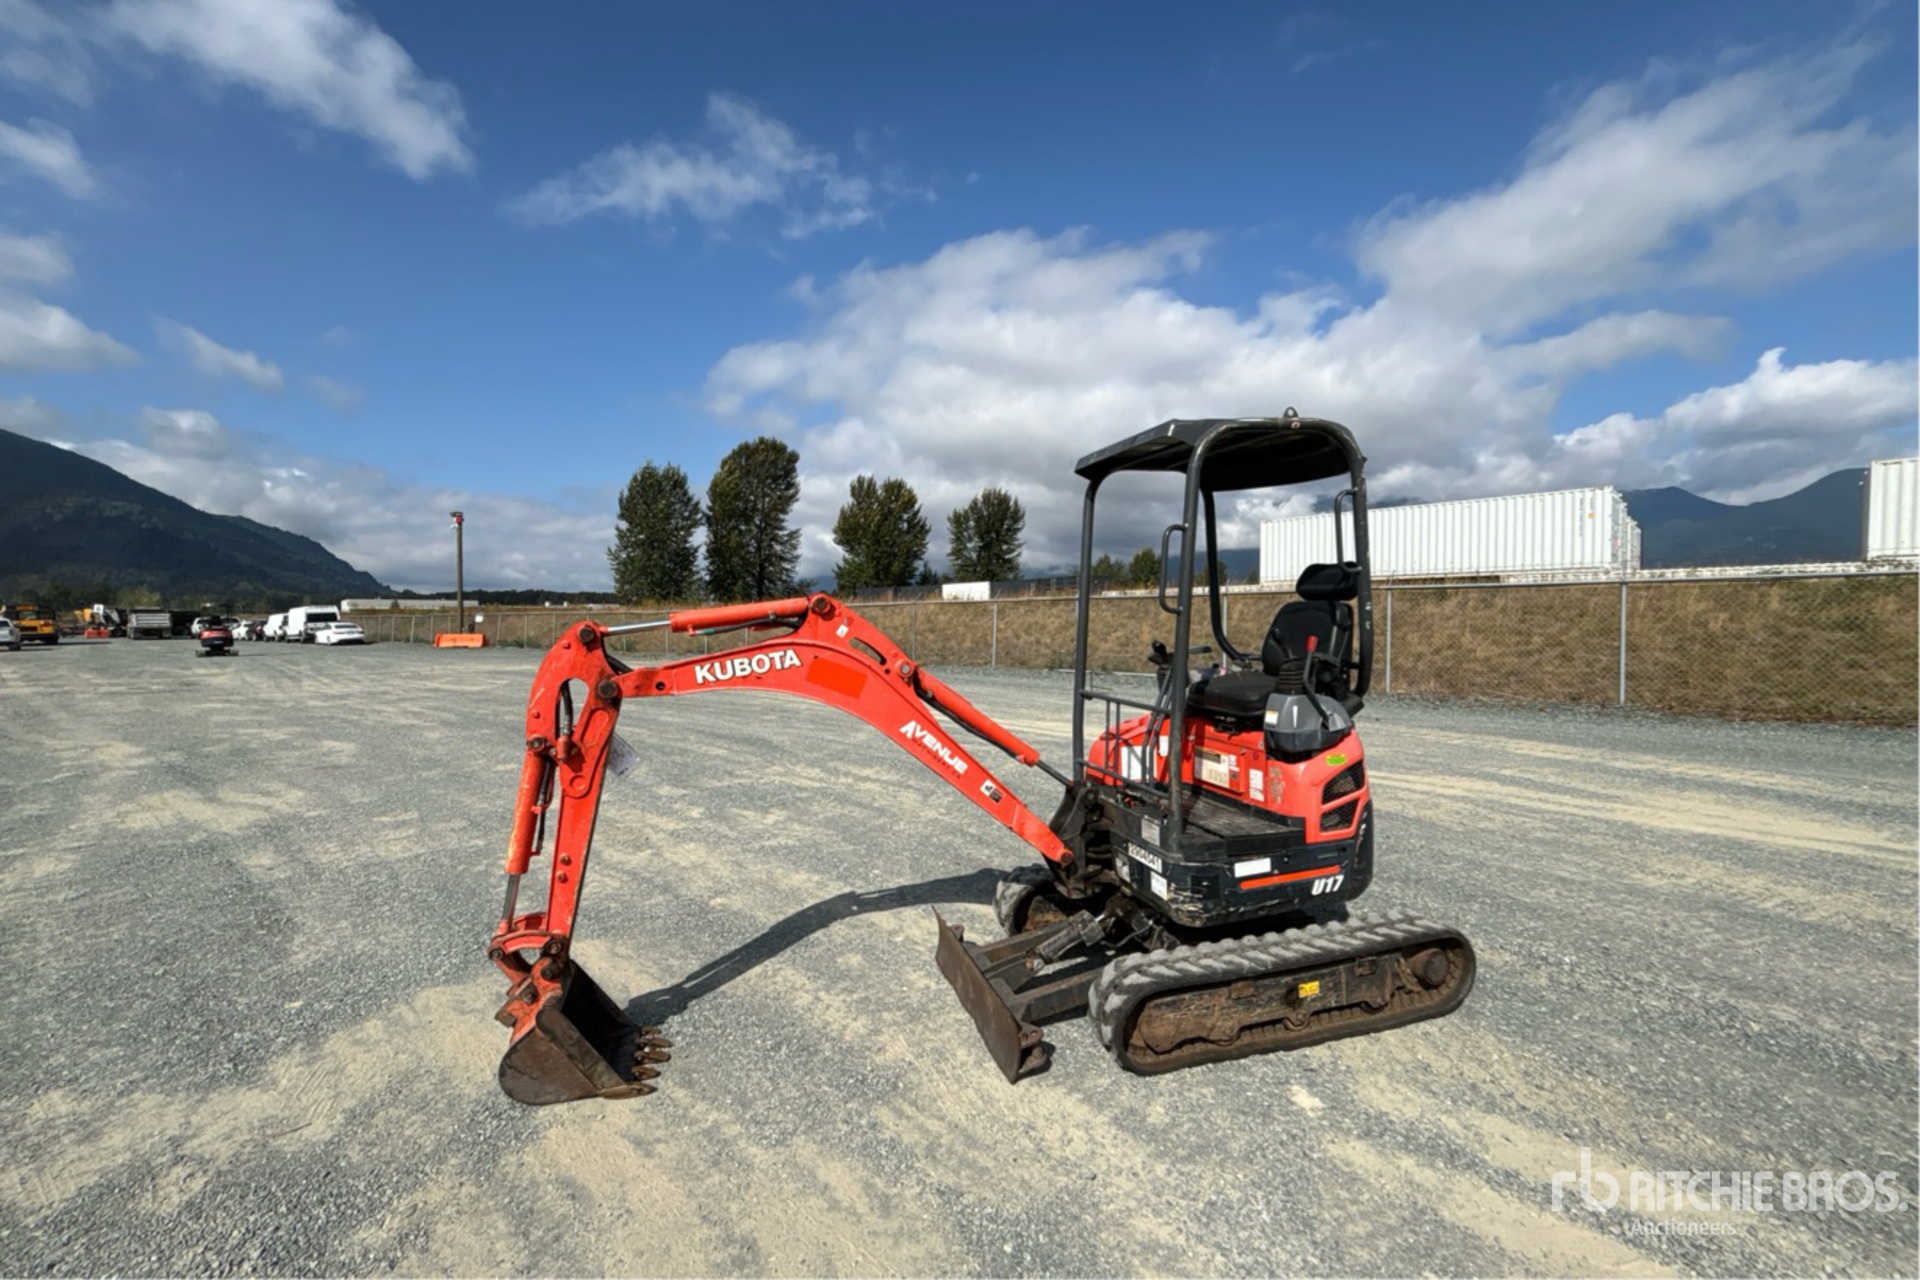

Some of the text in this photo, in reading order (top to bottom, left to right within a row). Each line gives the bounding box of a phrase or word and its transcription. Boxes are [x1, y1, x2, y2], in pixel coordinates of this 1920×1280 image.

[694, 649, 801, 684] KUBOTA
[899, 719, 969, 775] AVENUE
[1311, 874, 1345, 896] U17
